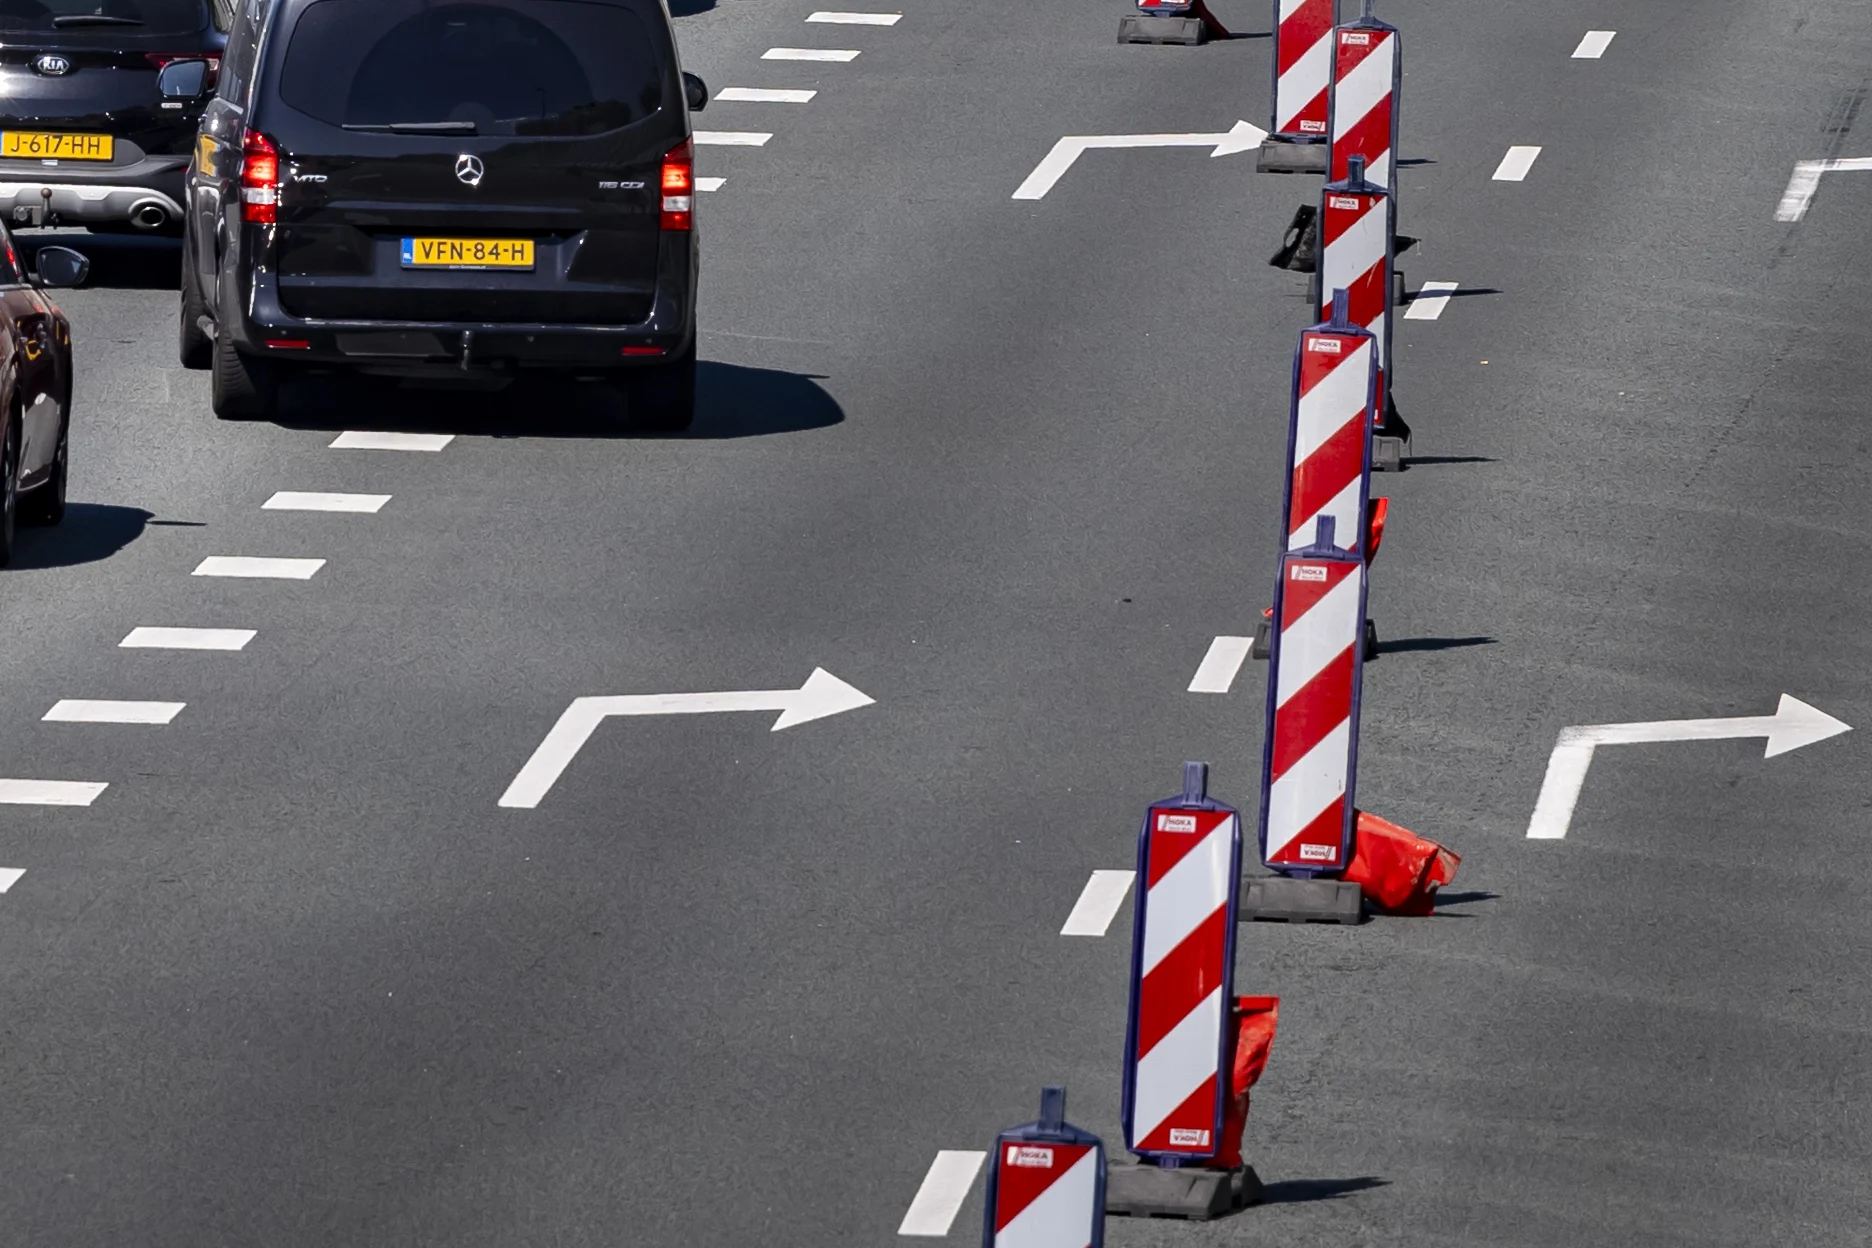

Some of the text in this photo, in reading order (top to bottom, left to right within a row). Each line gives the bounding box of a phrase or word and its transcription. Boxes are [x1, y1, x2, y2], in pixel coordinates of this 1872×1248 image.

[43, 57, 65, 70] KIA
[9, 134, 101, 154] J-617-HH
[420, 240, 525, 261] VFN-84-H
